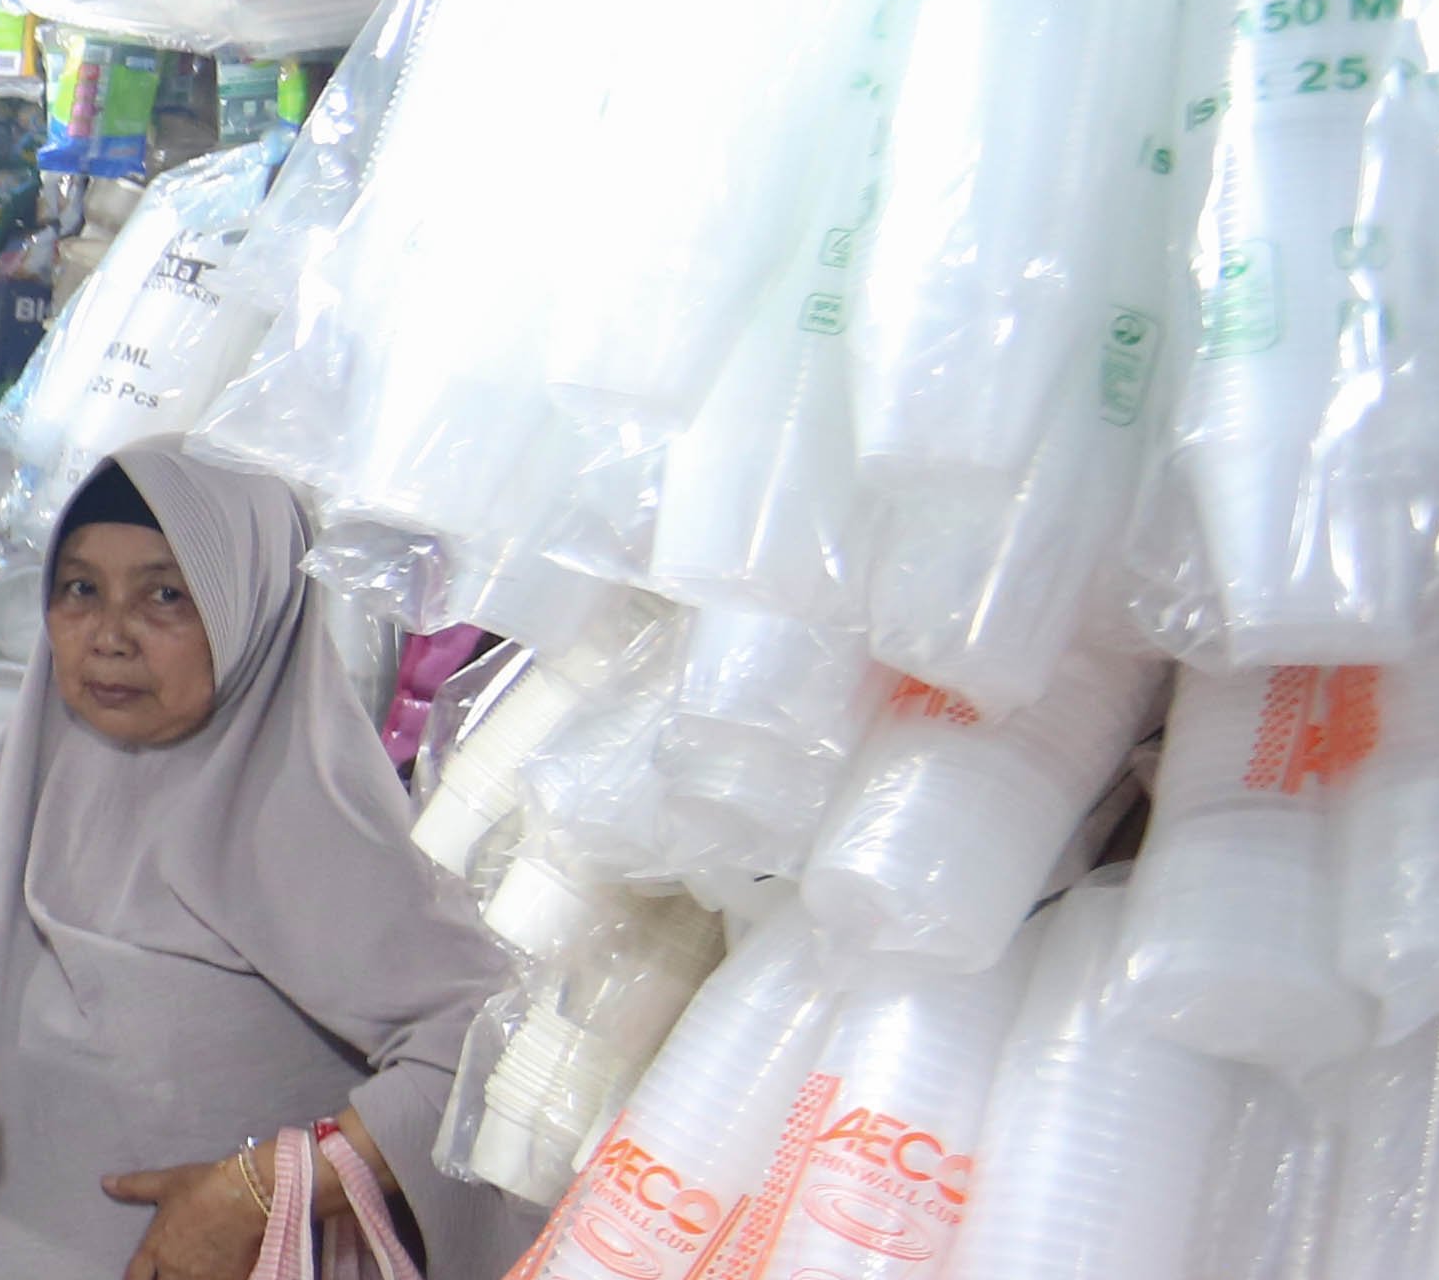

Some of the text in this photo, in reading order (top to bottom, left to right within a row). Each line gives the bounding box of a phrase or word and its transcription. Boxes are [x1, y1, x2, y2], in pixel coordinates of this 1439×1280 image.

[1295, 56, 1369, 94] 25
[118, 381, 161, 409] Pcs
[820, 1106, 977, 1206] AECO
[600, 1136, 721, 1236] AECO
[653, 1223, 697, 1257] CUP
